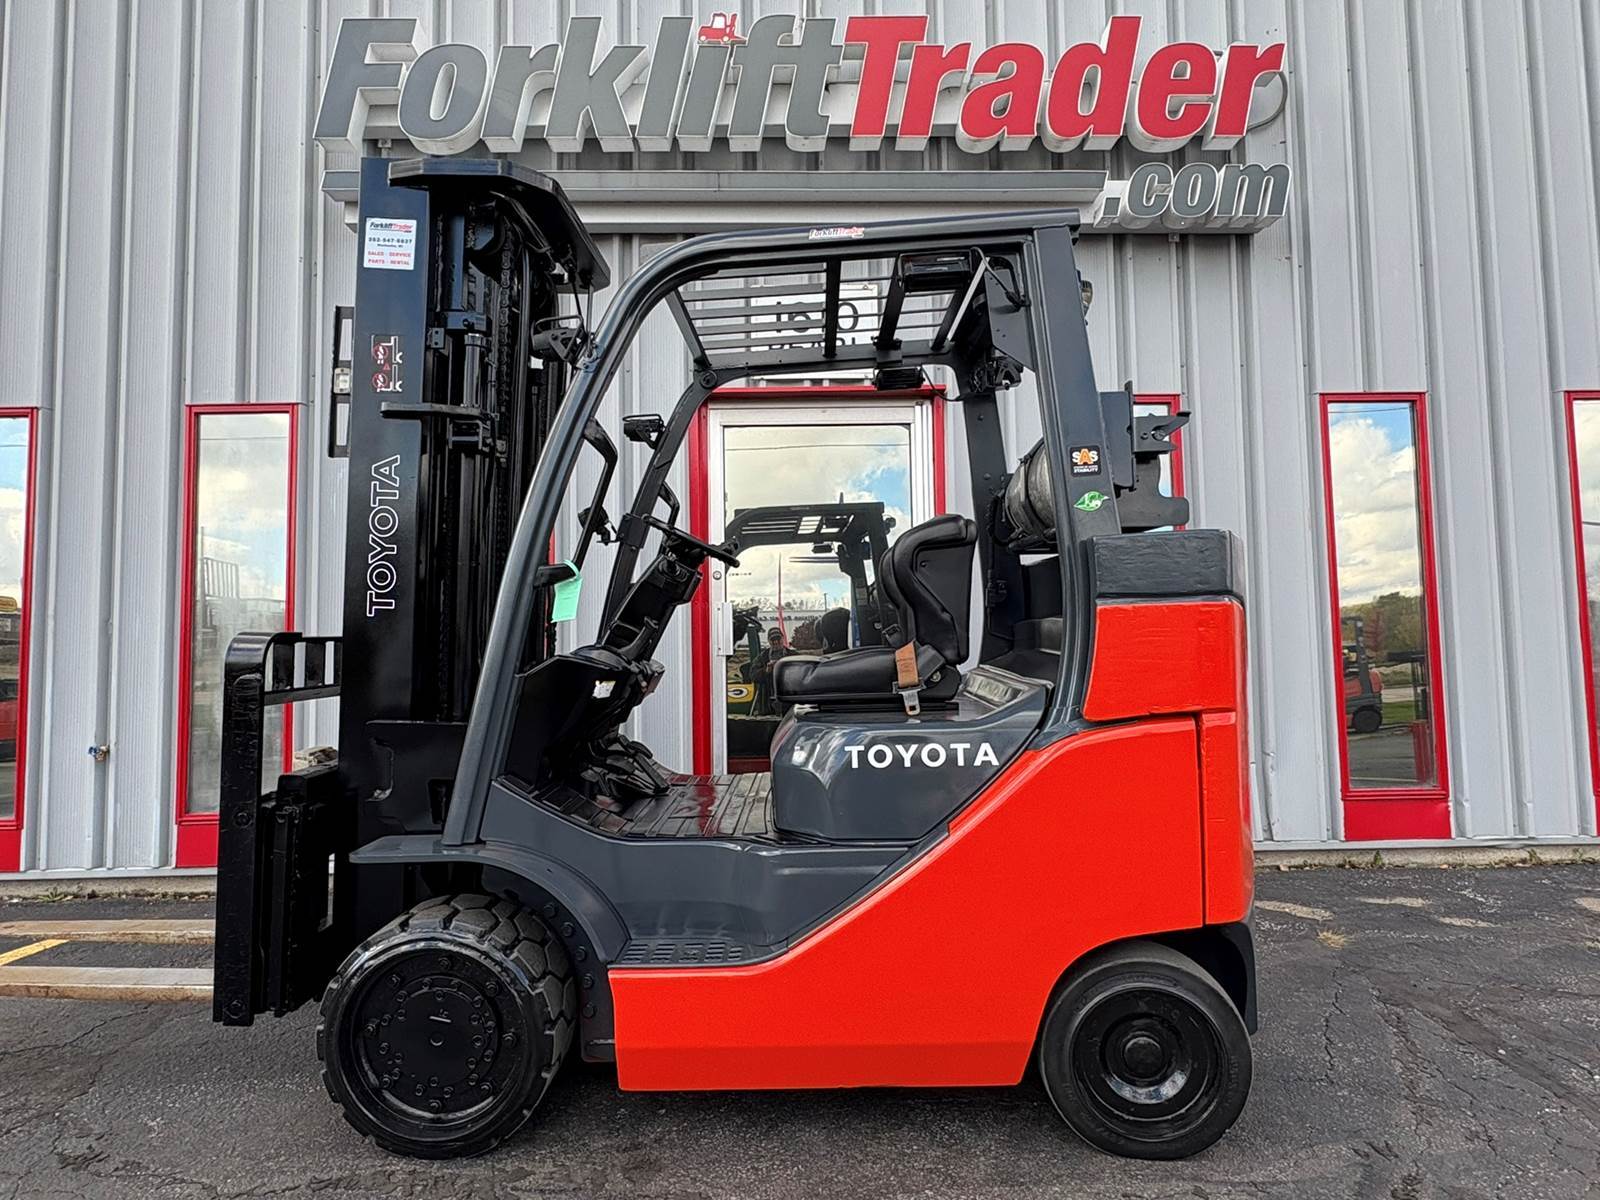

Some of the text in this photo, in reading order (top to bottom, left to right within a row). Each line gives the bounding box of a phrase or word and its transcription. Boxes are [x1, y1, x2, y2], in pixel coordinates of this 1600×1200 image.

[313, 13, 1286, 146] ForkliftTrader
[1099, 161, 1292, 219] .com
[1071, 448, 1099, 464] SAS
[366, 454, 401, 617] TOYOTA
[844, 742, 1000, 769] TOYOTA
